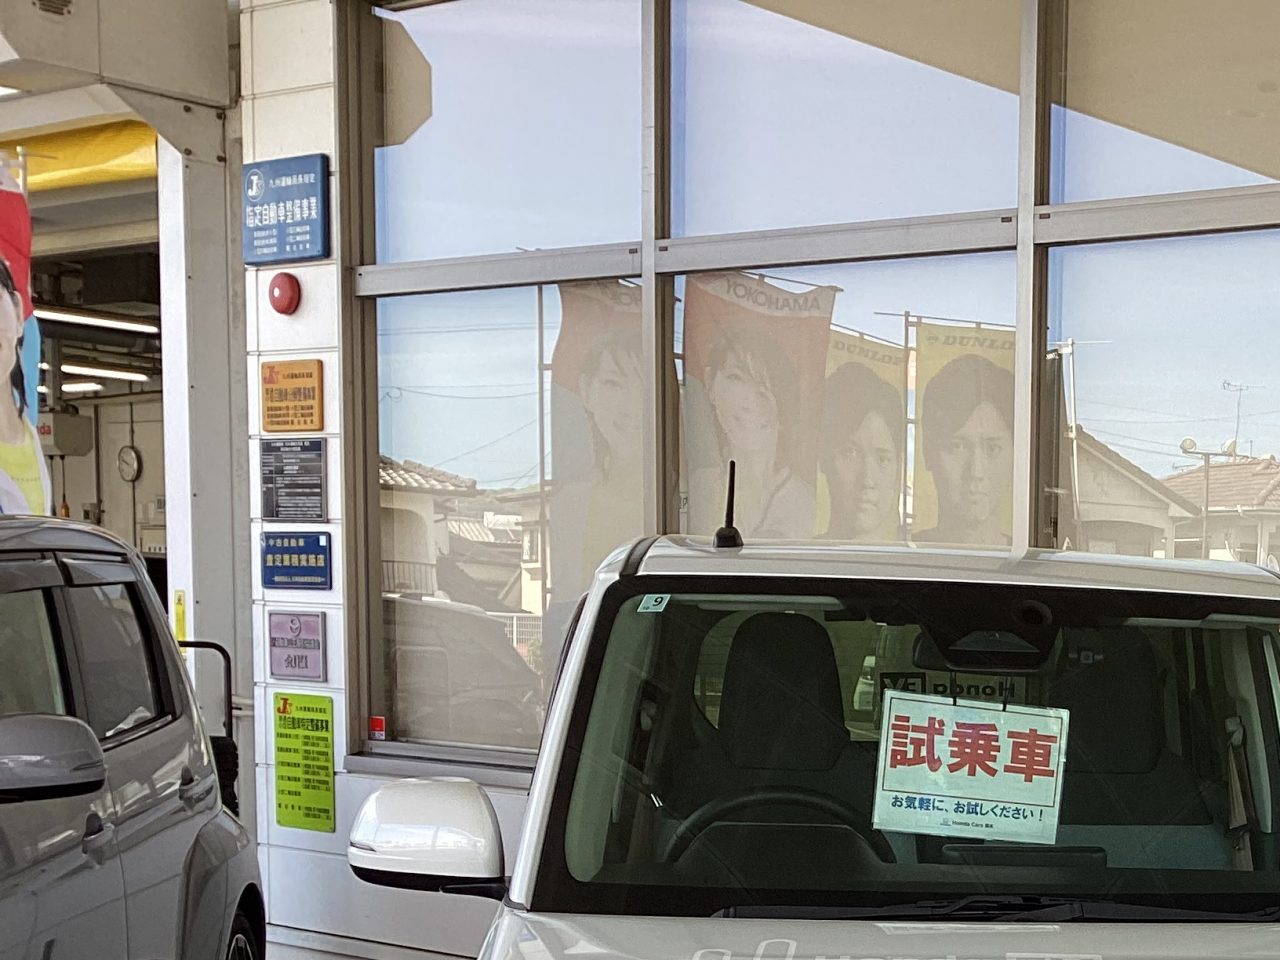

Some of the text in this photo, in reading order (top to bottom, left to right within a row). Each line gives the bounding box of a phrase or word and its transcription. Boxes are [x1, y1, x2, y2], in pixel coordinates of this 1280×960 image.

[726, 278, 820, 311] YOKOHAMA
[943, 334, 1016, 351] DUNLO
[652, 596, 664, 607] 9
[889, 714, 1058, 783] 試乗車
